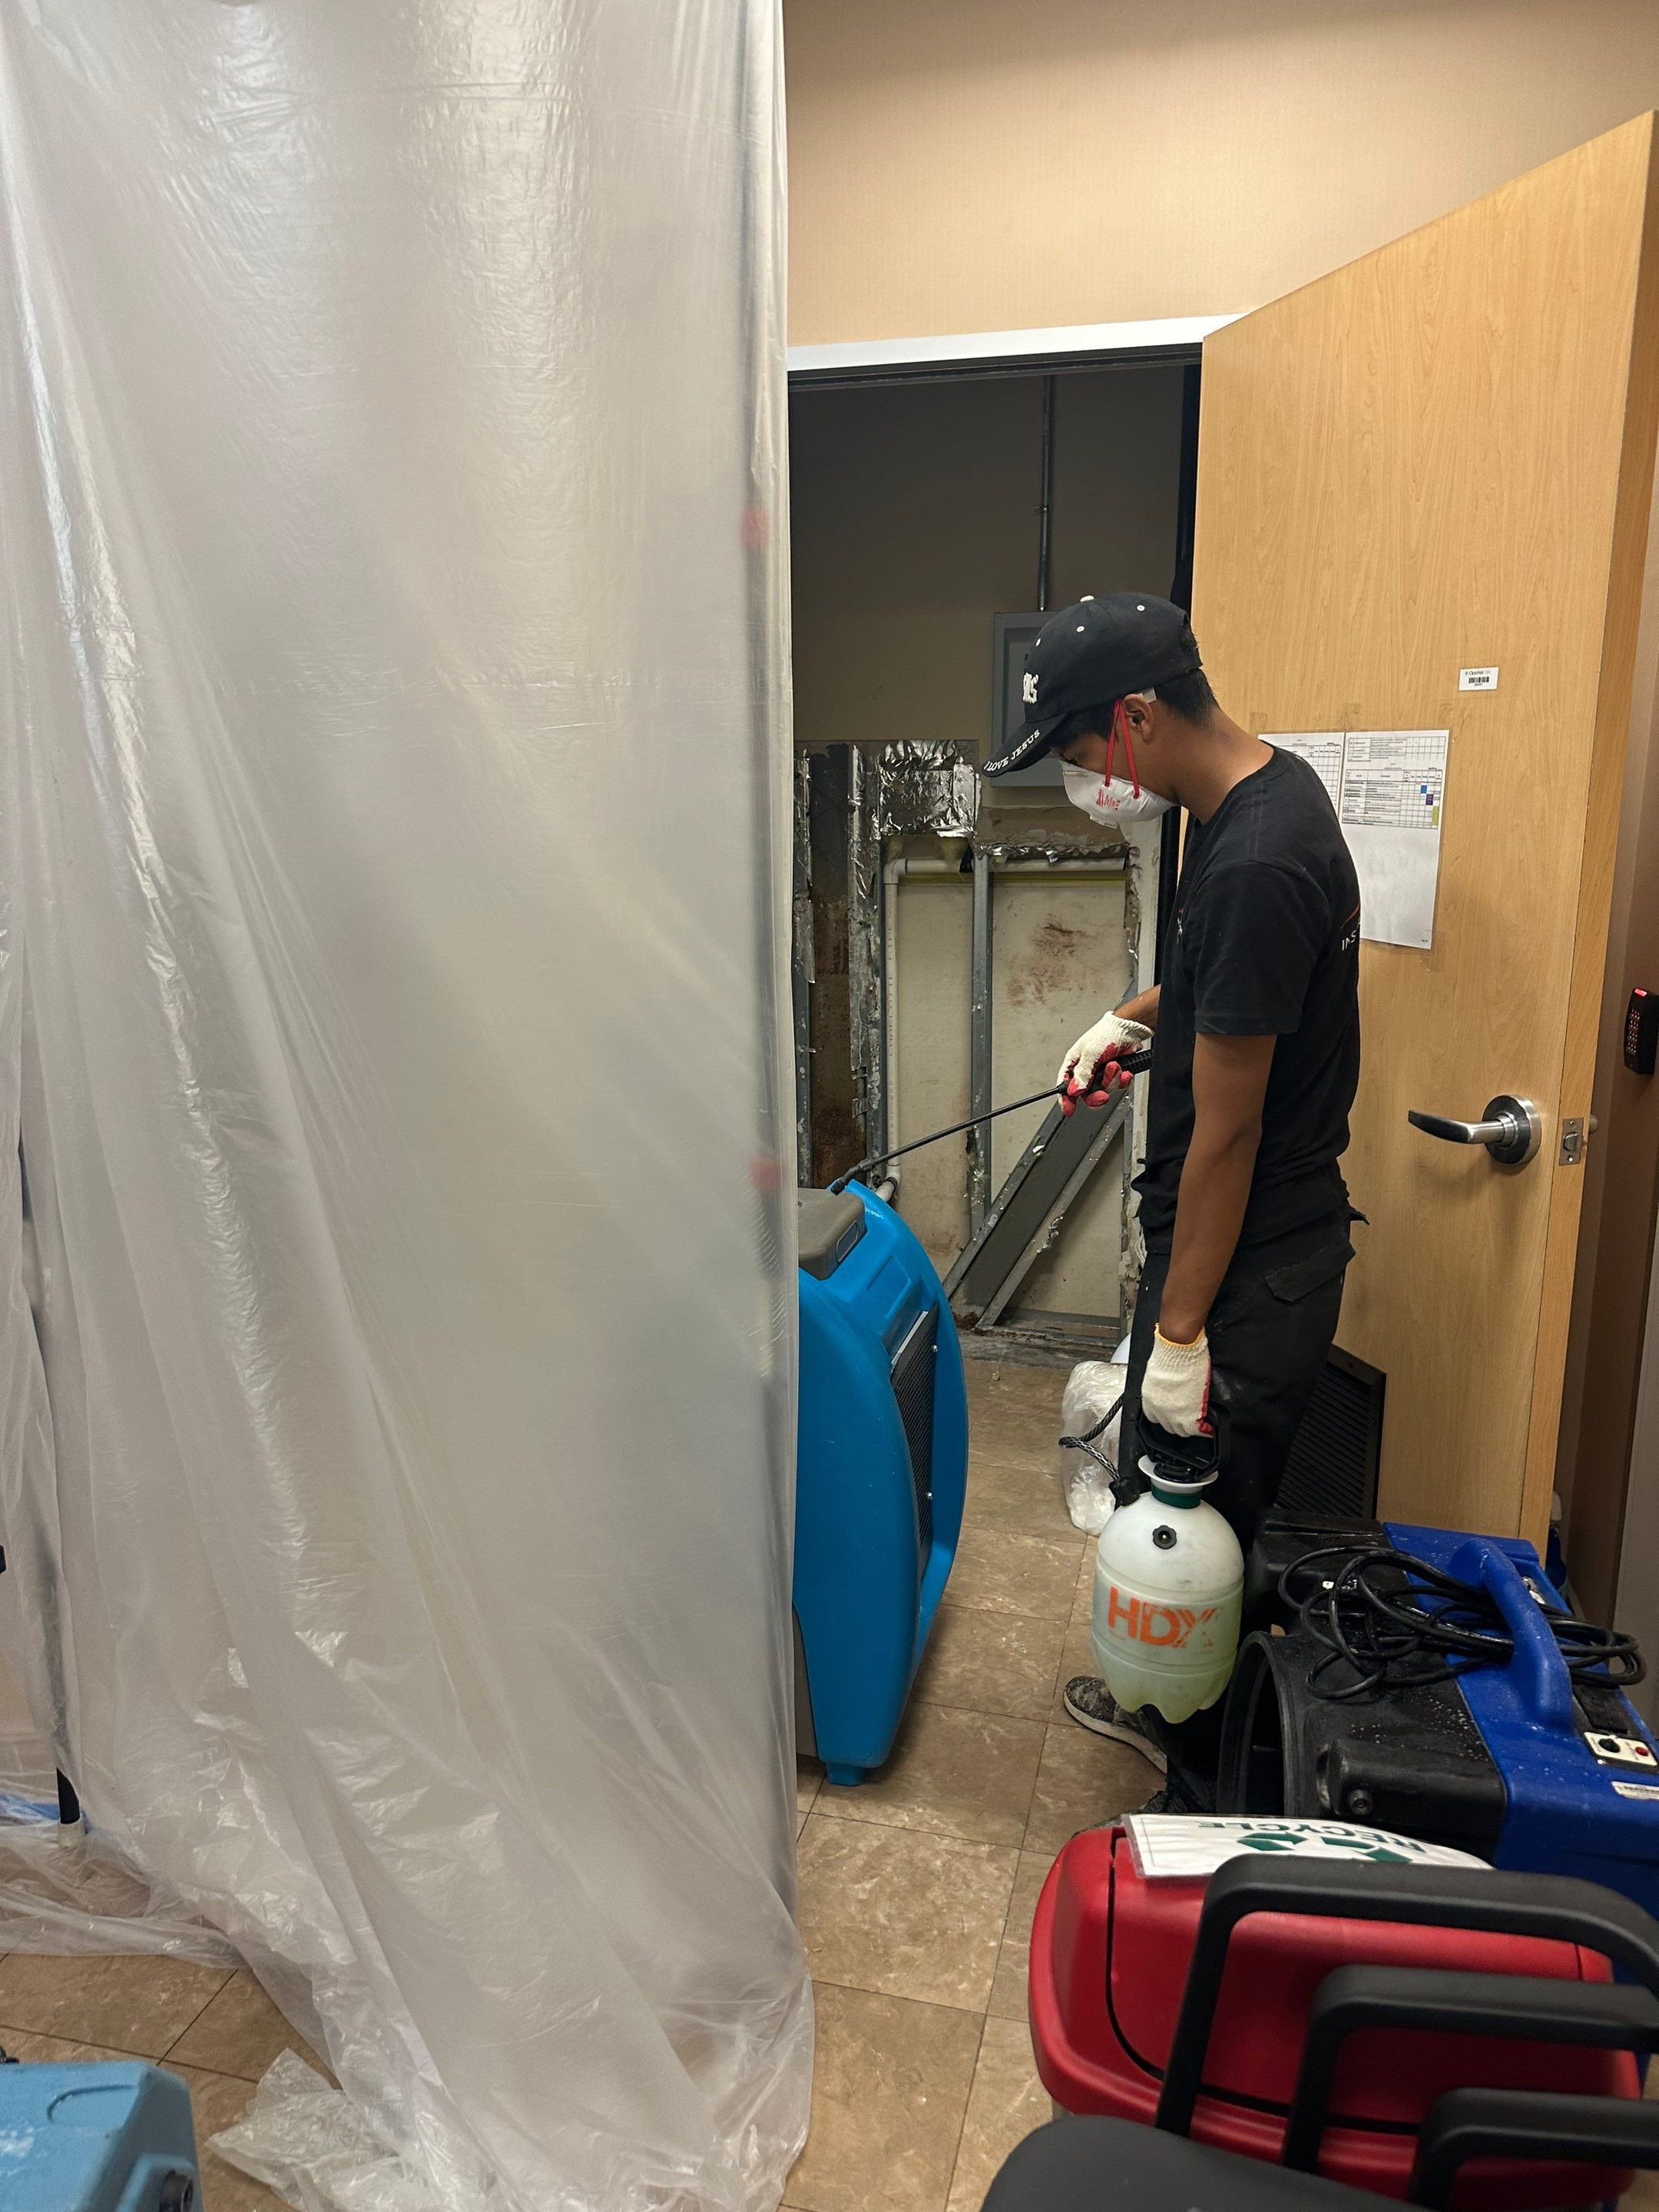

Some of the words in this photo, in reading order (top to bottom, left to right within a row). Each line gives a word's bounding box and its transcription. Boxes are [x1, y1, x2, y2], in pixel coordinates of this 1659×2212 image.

[1011, 729, 1040, 760] JESUS
[1342, 924, 1359, 951] INS
[1108, 1586, 1218, 1647] HDX
[1196, 1820, 1426, 1853] RECYCLE
